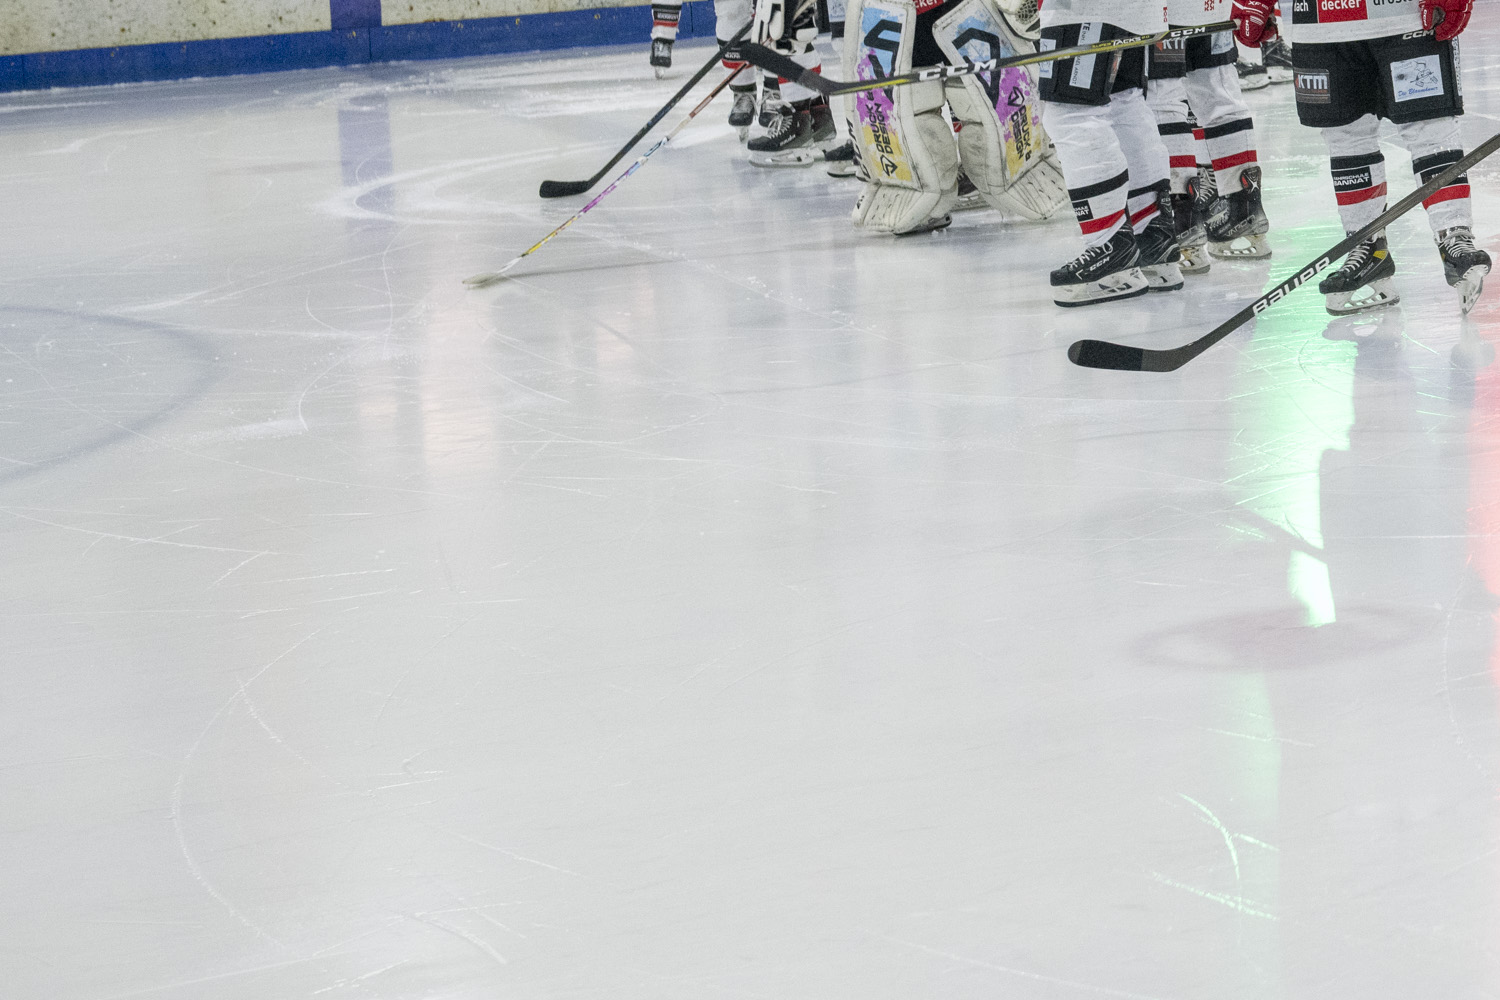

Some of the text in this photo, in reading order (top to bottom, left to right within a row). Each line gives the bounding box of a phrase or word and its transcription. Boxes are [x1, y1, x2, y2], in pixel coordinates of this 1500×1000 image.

[1111, 35, 1141, 47] TACKS
[1170, 26, 1207, 38] CCM
[1402, 28, 1435, 40] CCM
[919, 59, 997, 82] CCM
[1298, 74, 1329, 91] KTM
[866, 103, 885, 153] DRUCK
[874, 102, 894, 154] DESIGN
[1010, 111, 1024, 160] DESIGN
[1019, 104, 1031, 150] DRUCK
[1089, 257, 1110, 271] CCM
[1252, 256, 1331, 317] BAUER
